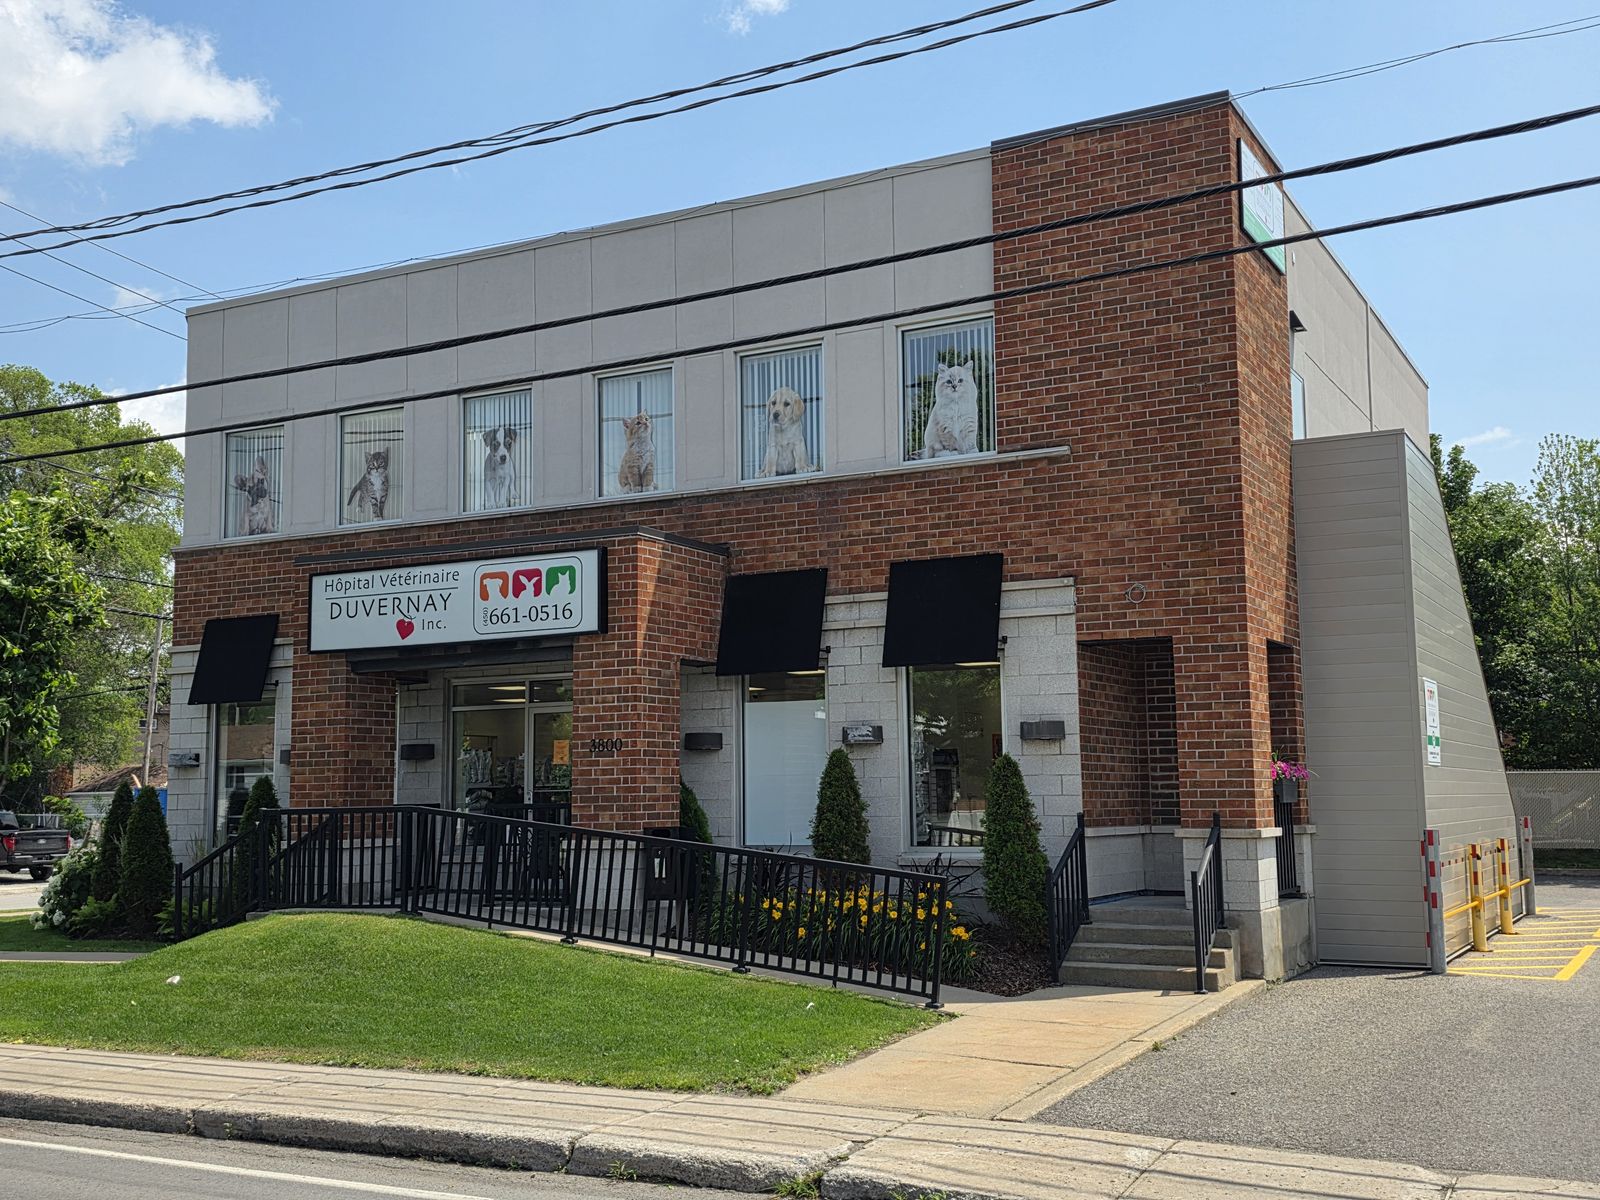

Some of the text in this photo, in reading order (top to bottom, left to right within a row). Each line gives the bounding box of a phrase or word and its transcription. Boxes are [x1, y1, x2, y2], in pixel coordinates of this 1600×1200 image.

[324, 568, 460, 595] Hôpital Vétérinaire
[330, 592, 452, 619] DUVERNAY
[489, 602, 573, 625] 661-0516
[421, 618, 447, 631] Inc.
[589, 737, 623, 753] 3800
